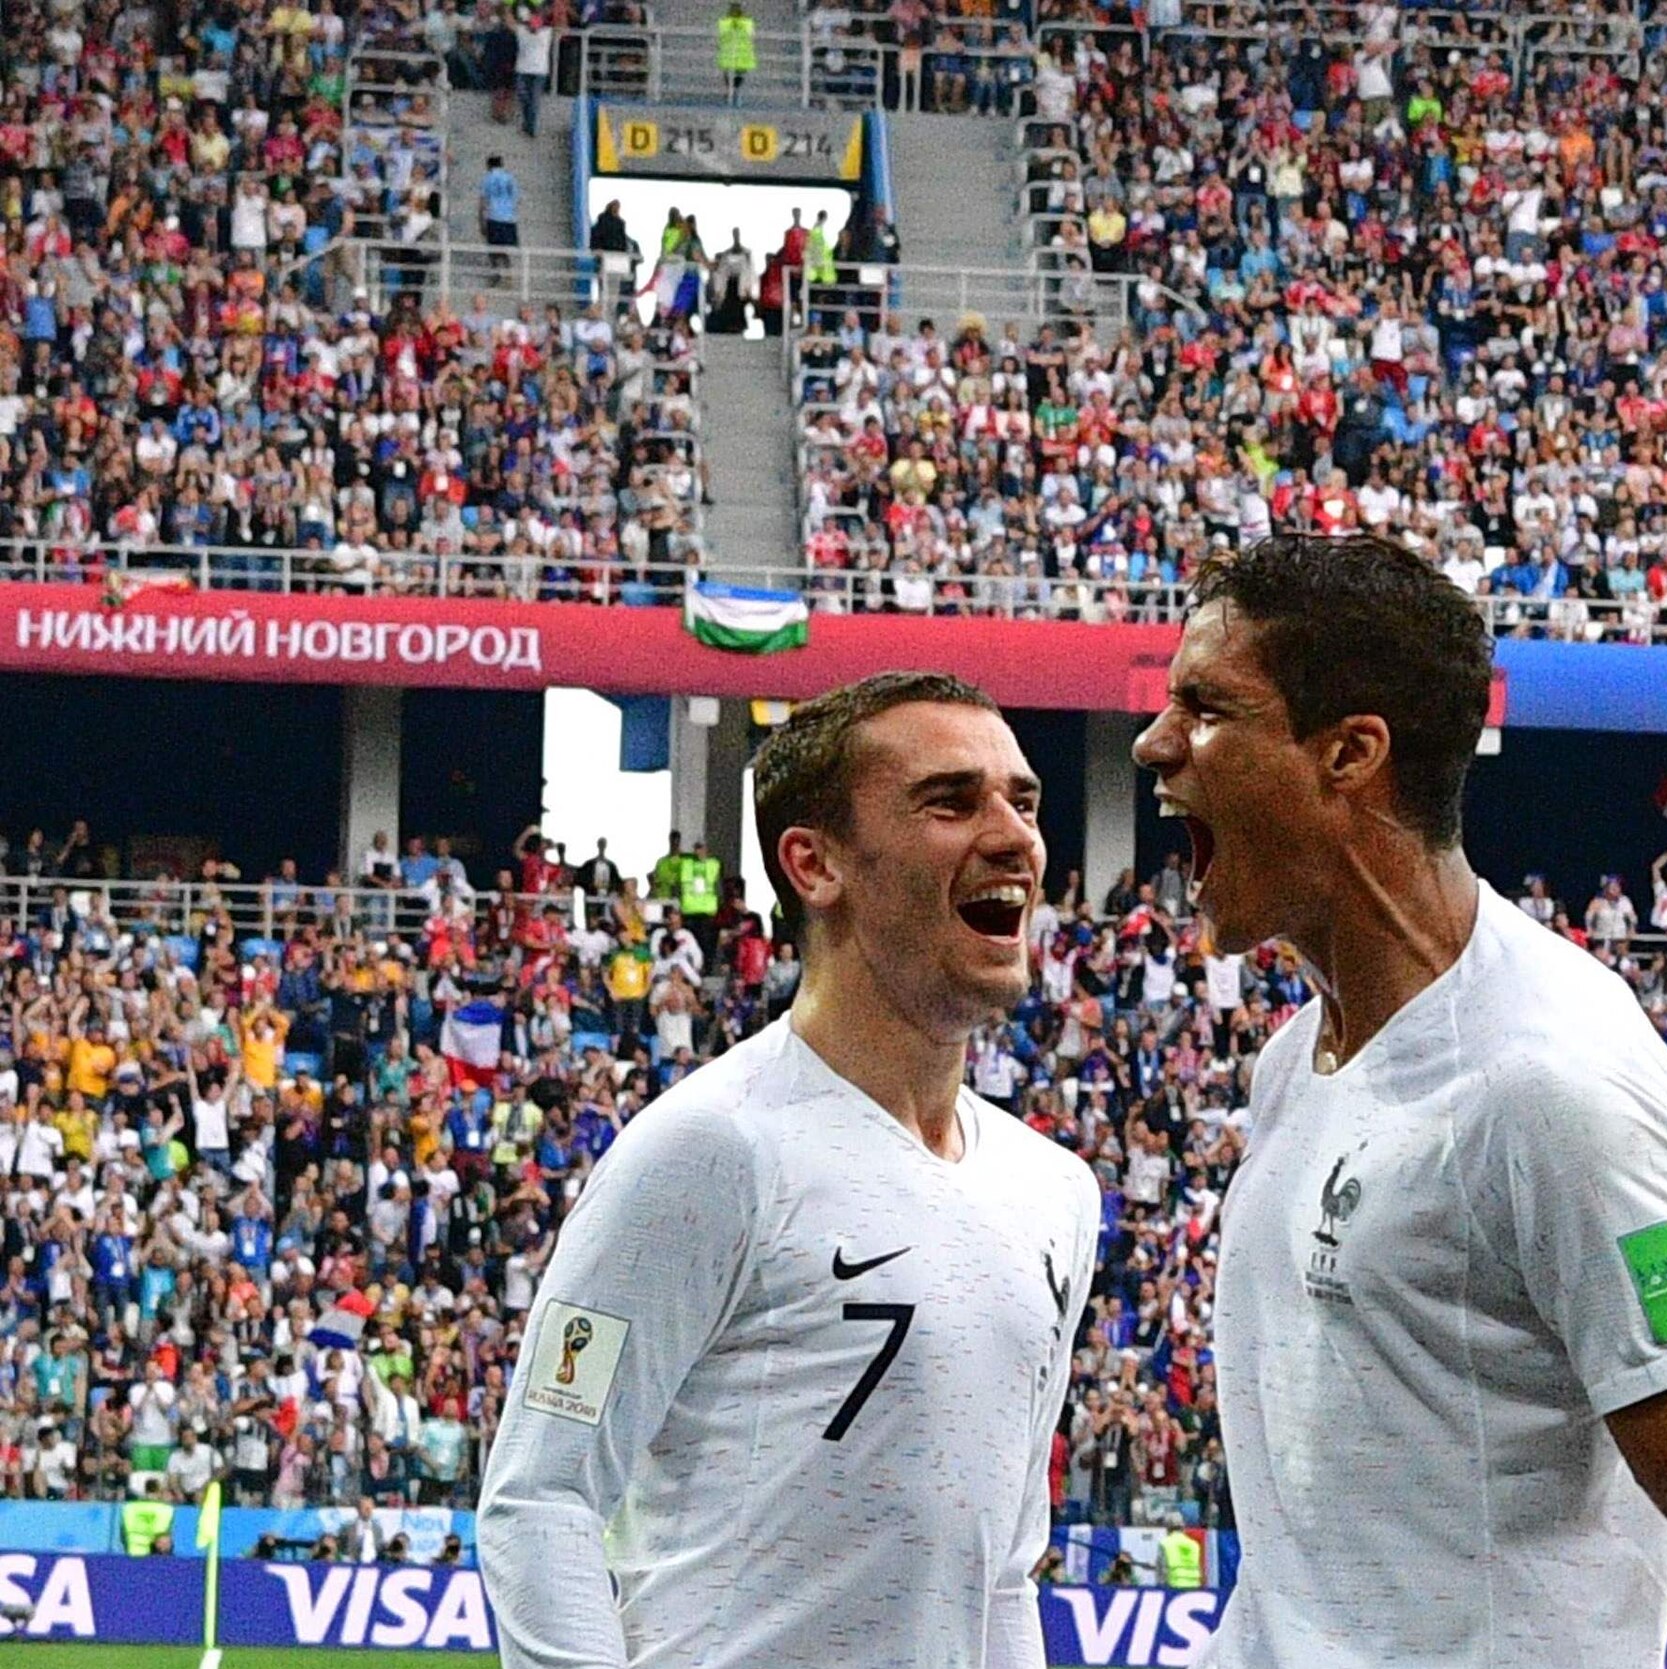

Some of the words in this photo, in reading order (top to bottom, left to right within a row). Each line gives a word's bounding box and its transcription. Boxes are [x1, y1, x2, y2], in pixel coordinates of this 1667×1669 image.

[631, 126, 652, 151] D
[666, 128, 715, 153] 215
[781, 132, 832, 158] 214
[16, 608, 256, 657] НИЖНИЙ
[265, 619, 543, 672] НОВГОРОД
[822, 1303, 916, 1442] 7
[266, 1563, 494, 1649] VISA
[1051, 1588, 1217, 1667] VIS
